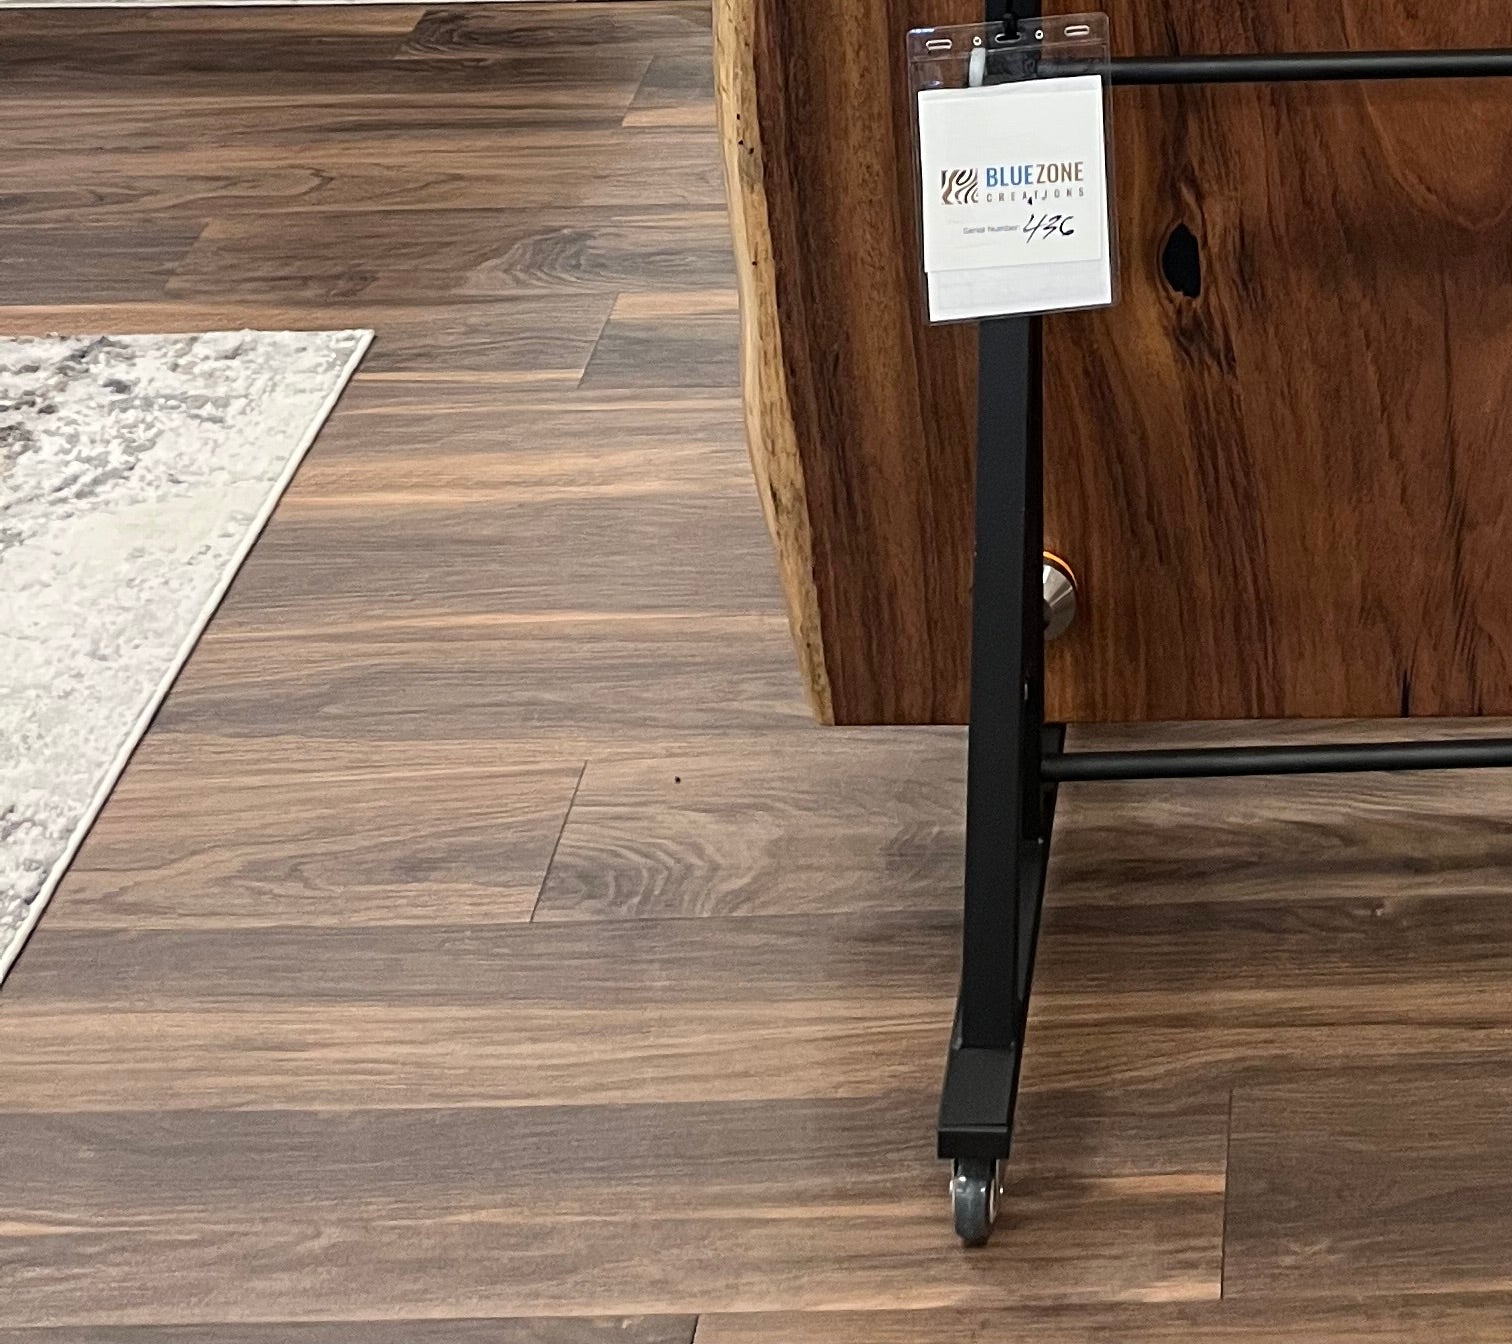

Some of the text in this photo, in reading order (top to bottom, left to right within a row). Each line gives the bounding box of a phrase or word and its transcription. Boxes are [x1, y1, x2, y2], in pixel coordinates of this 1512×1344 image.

[985, 161, 1084, 188] BLUEZONE
[986, 187, 1084, 203] CREATIONS
[1023, 213, 1074, 244] 436
